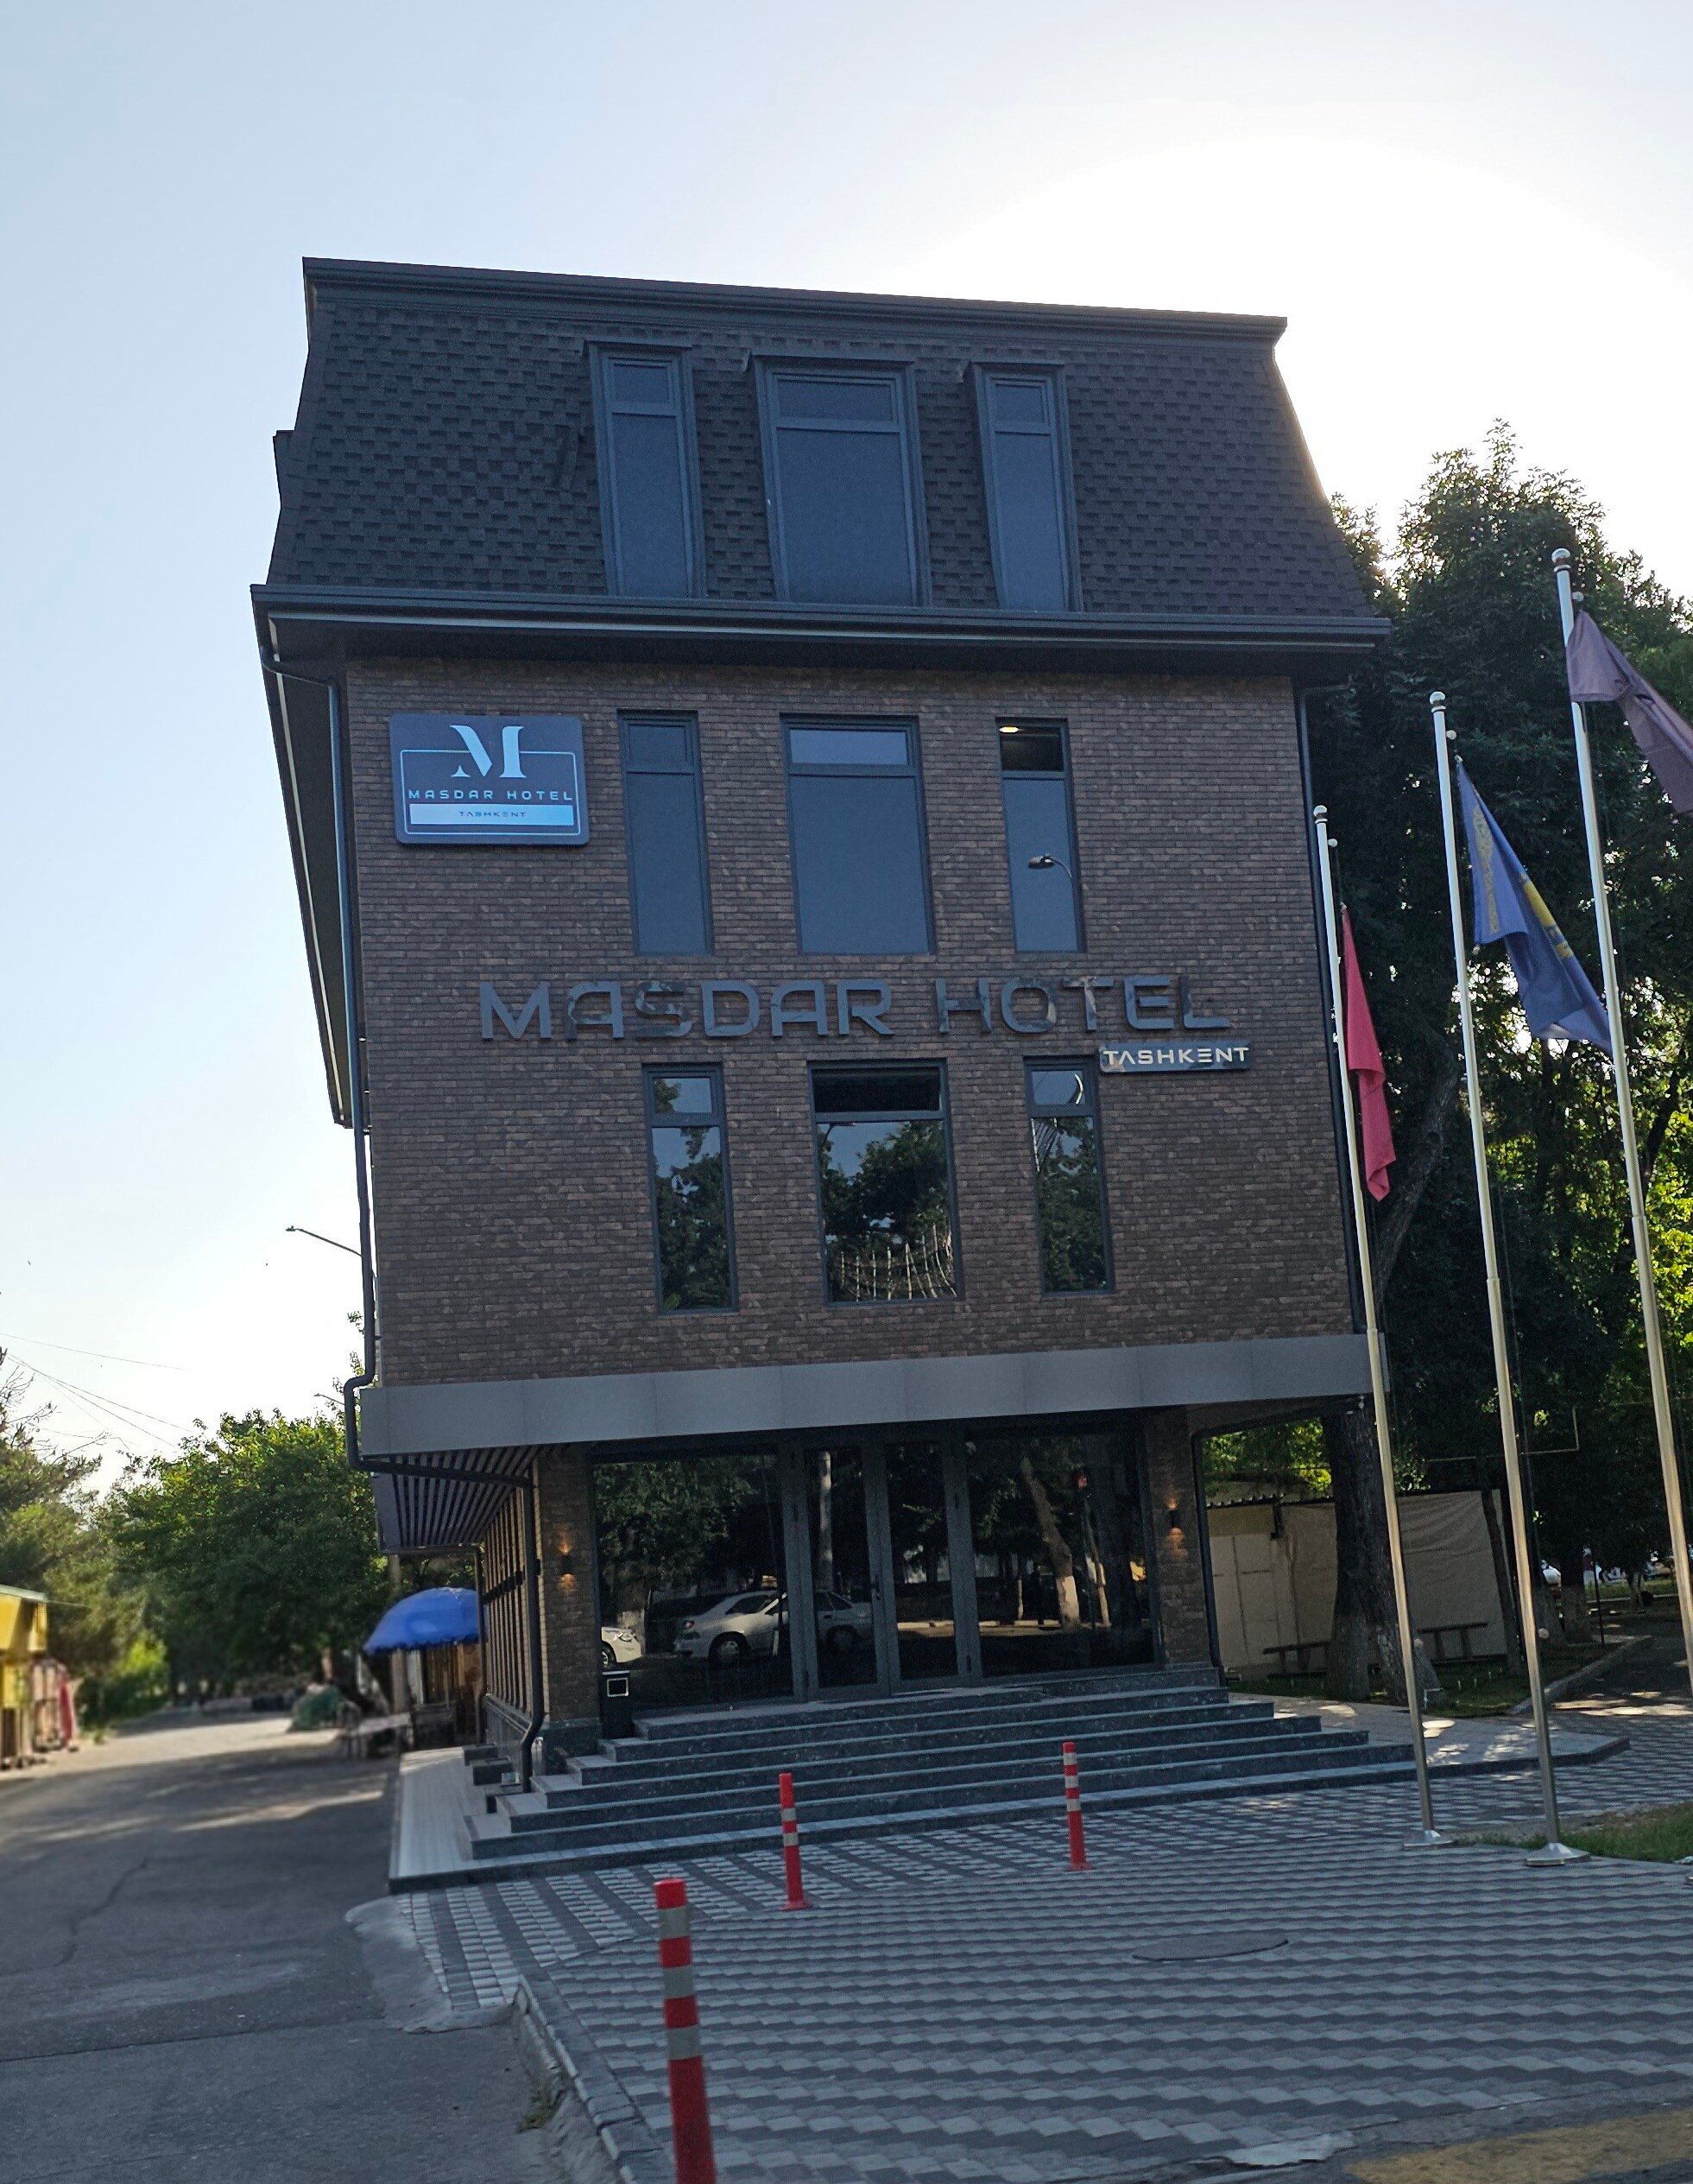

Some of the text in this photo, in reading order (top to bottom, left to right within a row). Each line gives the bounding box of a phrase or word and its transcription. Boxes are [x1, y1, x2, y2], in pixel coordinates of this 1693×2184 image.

[449, 725, 527, 778] M
[407, 789, 573, 801] MASDAR HOTEL
[479, 975, 1231, 1040] MASDAR HOTEL
[1102, 1047, 1250, 1066] TASHKENT
